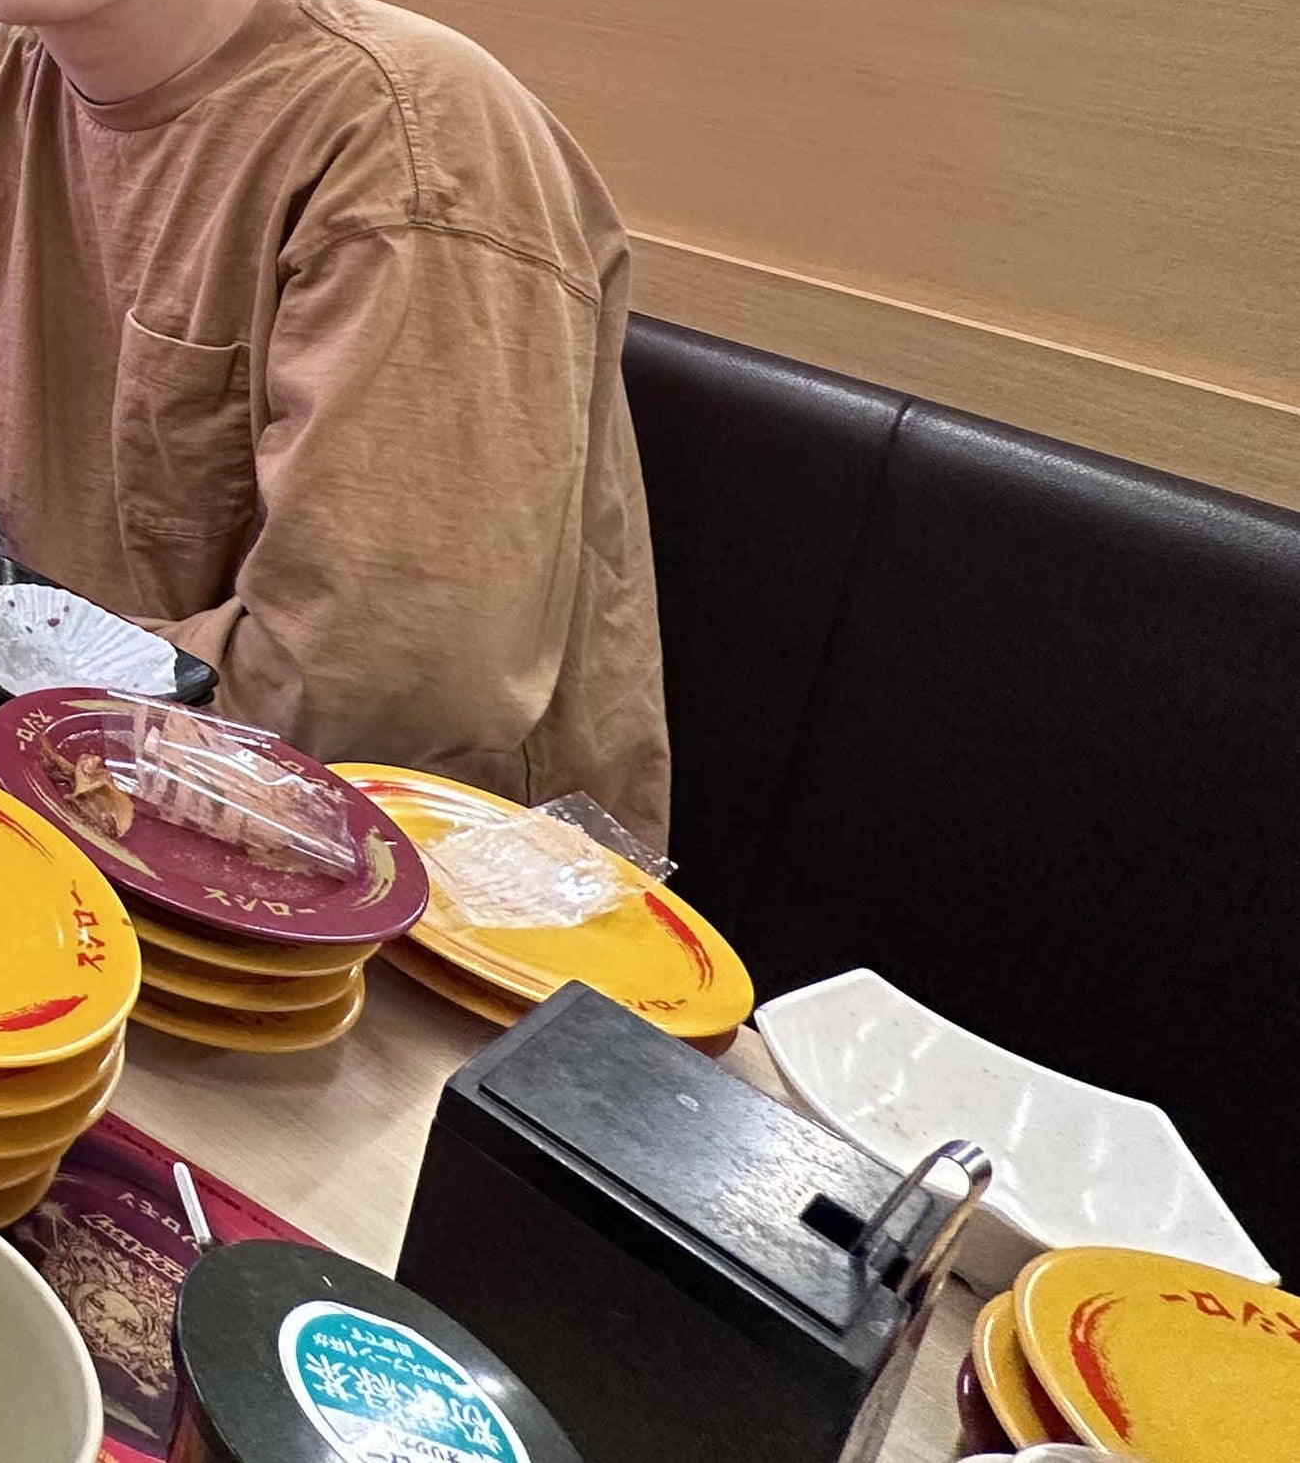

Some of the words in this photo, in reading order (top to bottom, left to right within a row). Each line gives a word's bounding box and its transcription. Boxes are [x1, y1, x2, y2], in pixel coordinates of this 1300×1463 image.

[71, 879, 106, 973] スシロー
[203, 886, 317, 917] スシロー
